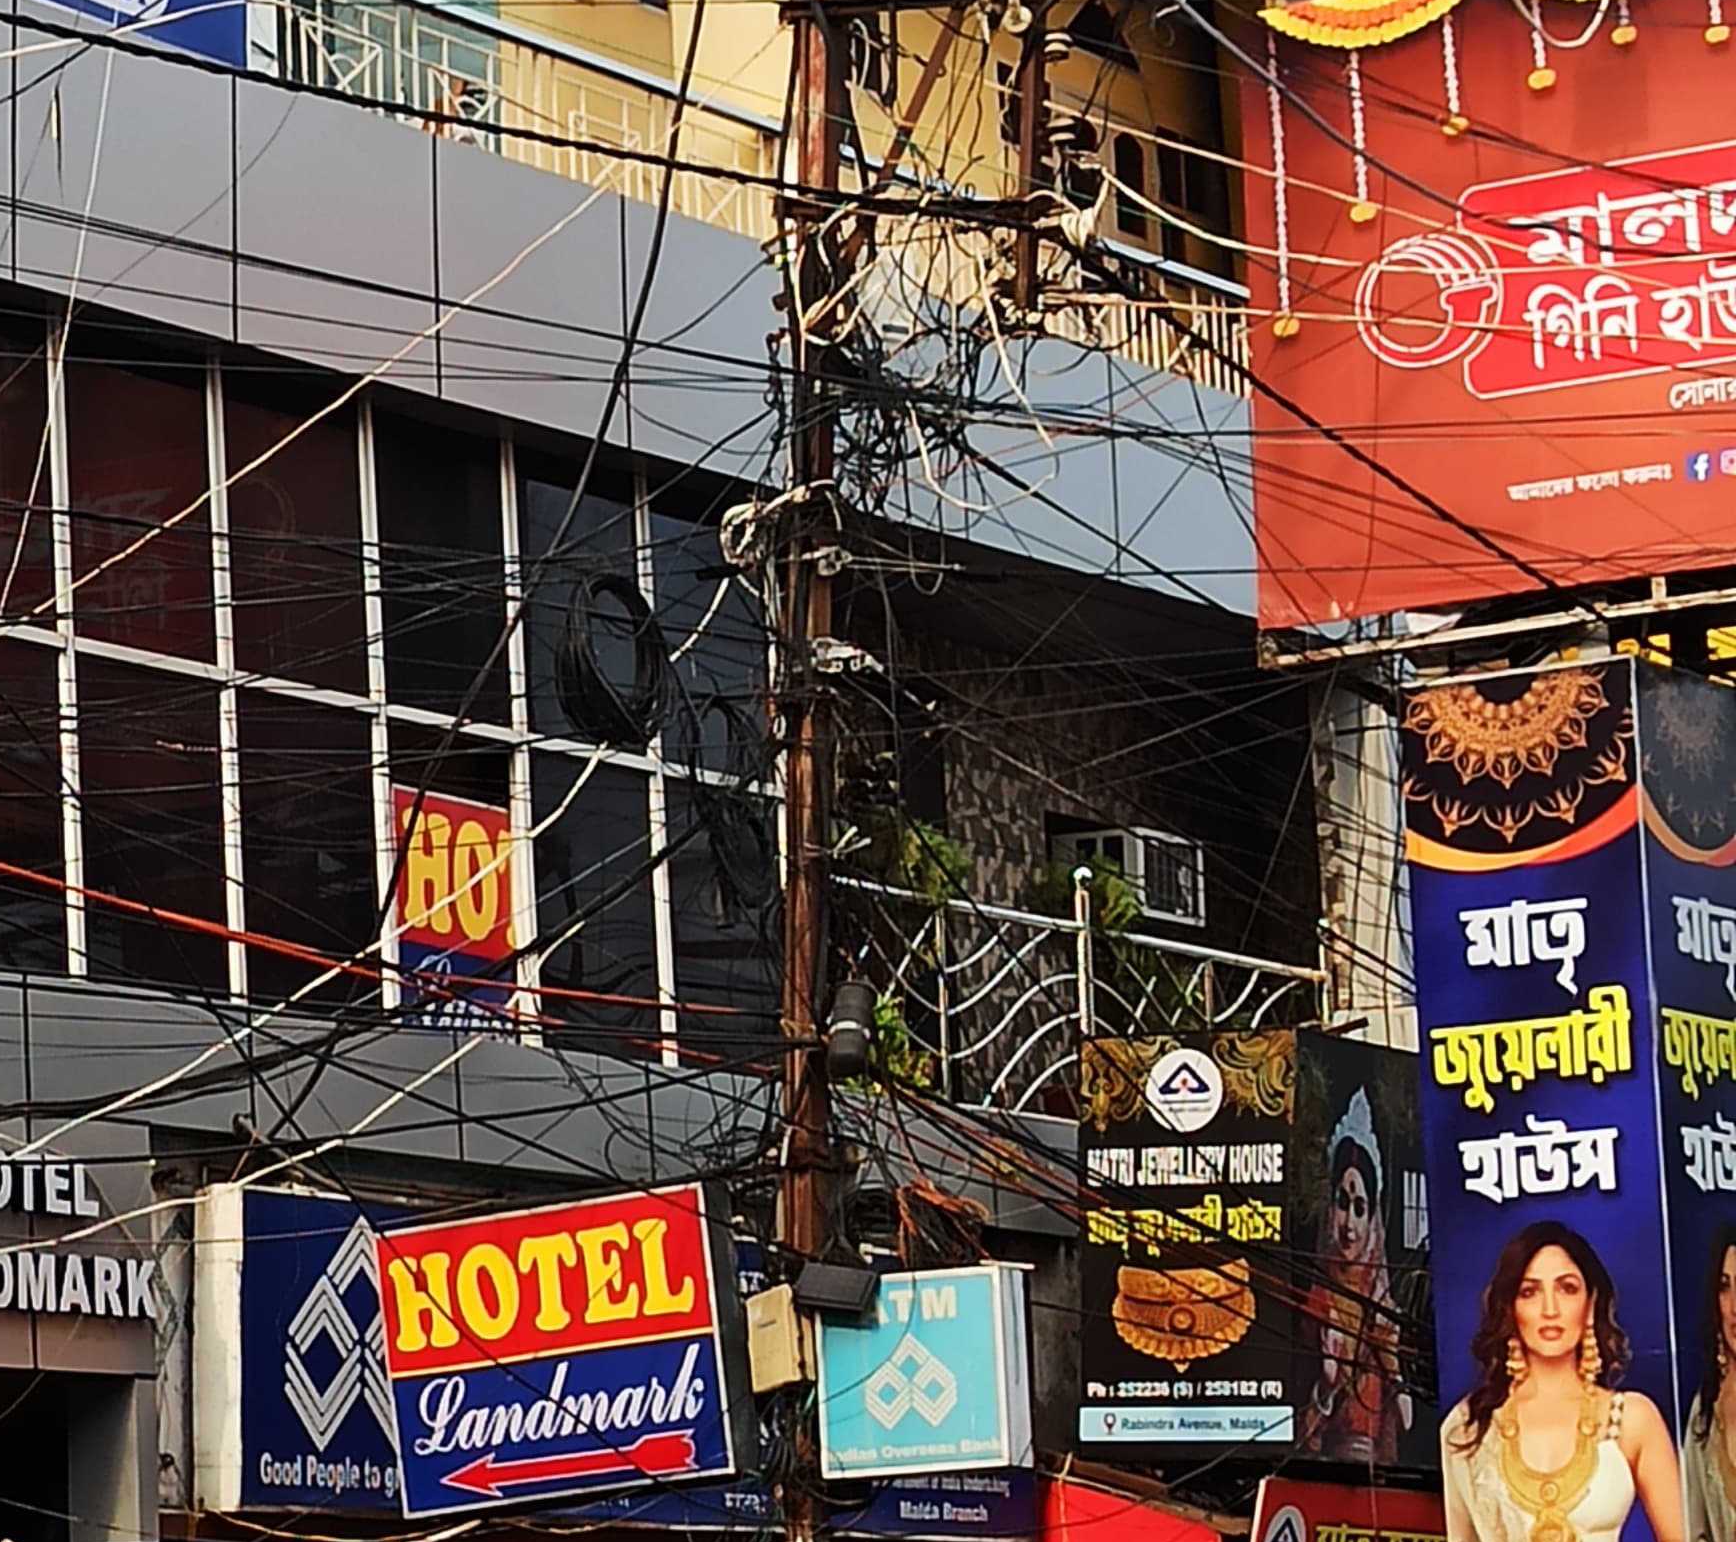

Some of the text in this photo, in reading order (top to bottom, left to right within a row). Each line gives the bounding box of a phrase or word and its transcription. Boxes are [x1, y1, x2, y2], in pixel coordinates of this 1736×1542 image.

[1522, 274, 1640, 370] গিনি
[401, 805, 518, 950] HO
[1460, 897, 1588, 994] মাতৃ
[1430, 984, 1633, 1113] জুয়েলারী
[1087, 1143, 1284, 1187] MATRI JEWELLERY HOUSE
[1460, 1115, 1619, 1204] হাউস
[388, 1218, 695, 1353] HOTEL
[414, 1342, 705, 1457] Landmark
[1121, 1417, 1174, 1430] Rabindra
[1178, 1417, 1226, 1432] Avenue,
[260, 1452, 302, 1486] Good
[306, 1454, 360, 1494] People
[364, 1459, 381, 1489] to
[900, 1500, 988, 1522] Malda Branch
